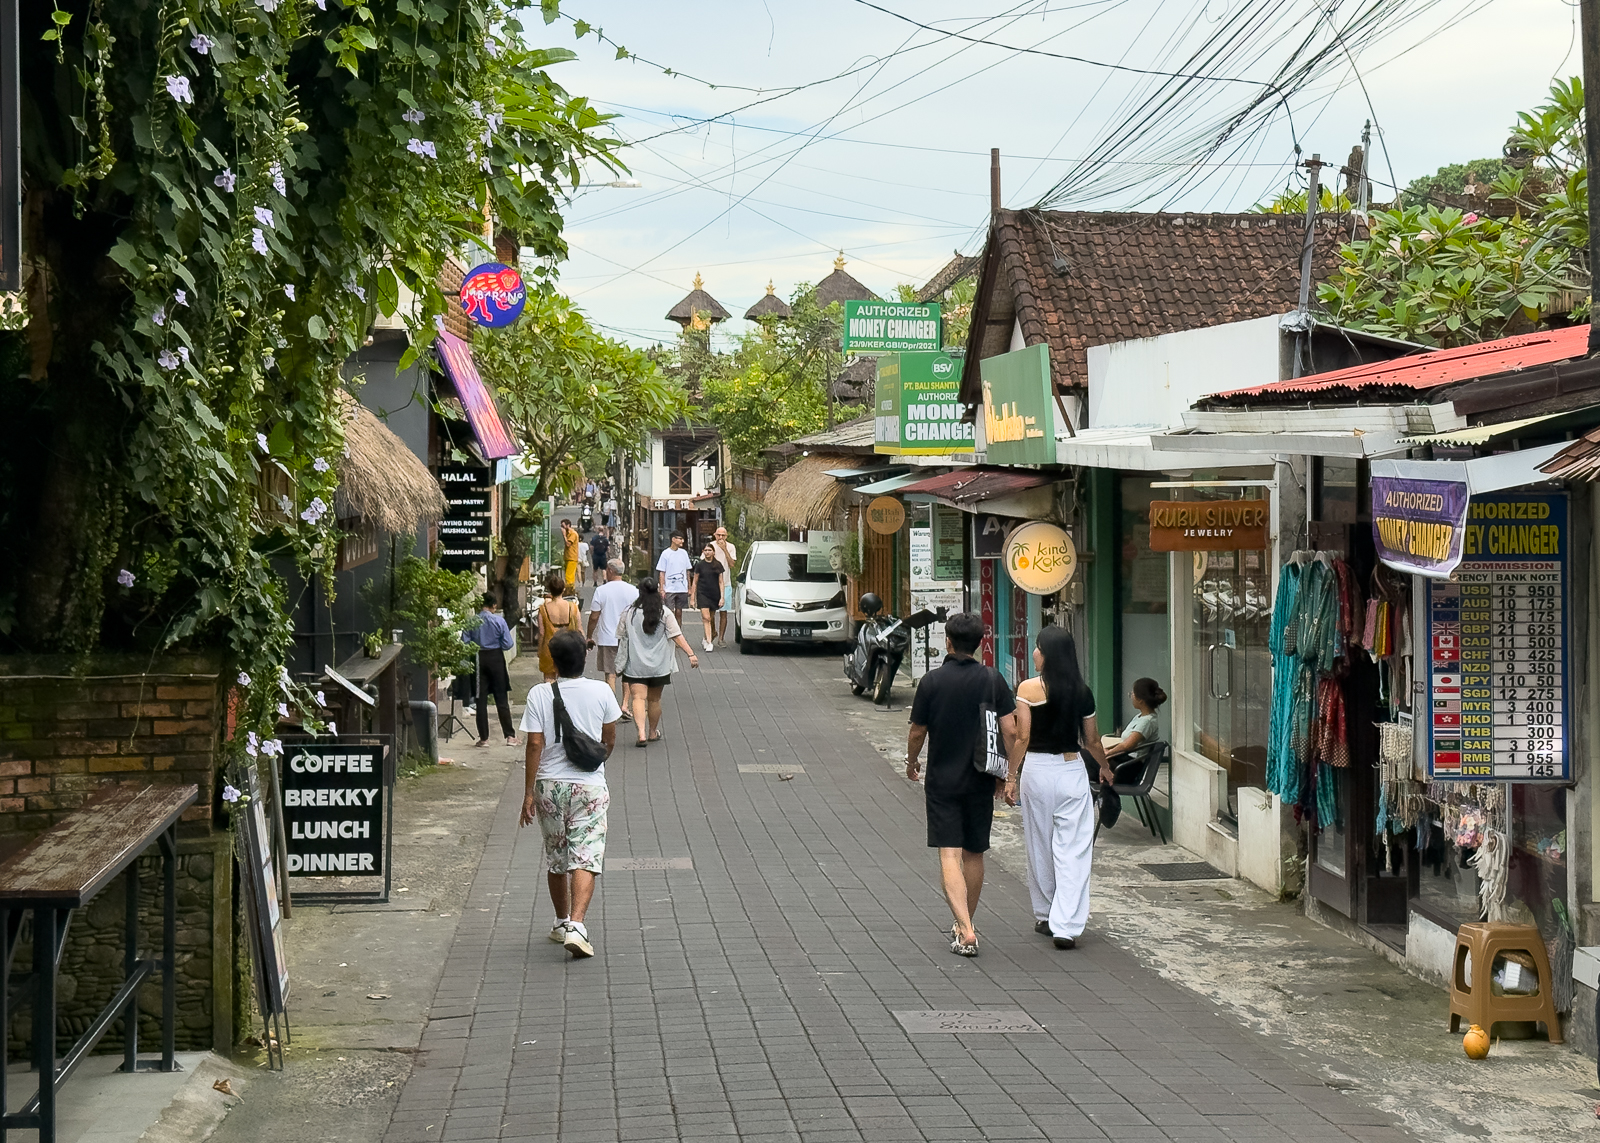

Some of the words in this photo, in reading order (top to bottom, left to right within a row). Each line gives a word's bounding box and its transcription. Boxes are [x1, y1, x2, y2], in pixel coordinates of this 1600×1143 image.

[857, 305, 930, 317] AUTHORIZED
[849, 318, 885, 338] MONEY
[887, 319, 937, 339] CHANGER
[933, 363, 952, 373] BSV
[903, 382, 914, 390] PT.
[915, 382, 930, 390] BALI
[931, 381, 955, 390] SHANTI
[918, 392, 958, 401] AUTHORIZ
[907, 403, 968, 420] MONE
[441, 473, 477, 482] HALAL
[1385, 491, 1444, 512] AUTHORIZED
[1467, 502, 1550, 519] HORIZED
[1153, 507, 1200, 528] KUBU
[1205, 507, 1264, 527] SILVER
[1183, 529, 1233, 537] JEWELRY
[1376, 516, 1408, 553] MONEY
[1409, 521, 1453, 560] CHANGER
[1488, 524, 1560, 555] CHANGER
[1037, 540, 1068, 556] kind
[1032, 555, 1072, 573] Koko
[1457, 573, 1489, 582] RENCY
[1496, 573, 1527, 582] BANK
[1530, 573, 1559, 581] NOTE
[1461, 586, 1490, 595] USD
[1498, 586, 1516, 597] 15
[1528, 585, 1555, 597] 950
[1462, 599, 1490, 608] AUD
[1498, 599, 1516, 609] 10
[1528, 598, 1555, 609] 175
[1462, 612, 1490, 621] EUR
[1498, 611, 1516, 622] 18
[1528, 611, 1555, 622] 175
[1462, 625, 1490, 633] GBP
[1498, 624, 1515, 635] 21
[1527, 624, 1555, 635] 625
[1462, 637, 1490, 646] CAD
[1498, 637, 1515, 648] 11
[1528, 637, 1555, 648] 500
[1462, 650, 1490, 659] CHF
[1498, 650, 1516, 661] 19
[1528, 650, 1555, 660] 425
[1462, 663, 1490, 672] NZD
[1506, 663, 1515, 674] 9
[1528, 663, 1555, 674] 350
[1462, 676, 1490, 685] JPY
[1499, 675, 1525, 686] 110
[1536, 675, 1554, 686] 50
[1462, 689, 1490, 698] SGD
[1499, 689, 1517, 699] 12
[1528, 688, 1555, 699] 275
[1462, 702, 1490, 710] MYR
[1507, 702, 1516, 713] 3
[1526, 701, 1554, 712] 400
[985, 709, 999, 733] DE
[1462, 715, 1491, 723] HKD
[1507, 714, 1514, 725] 1
[1527, 714, 1554, 725] 900
[1463, 728, 1491, 736] THB
[1528, 727, 1555, 738] 300
[1463, 741, 1491, 749] SAR
[1509, 740, 1518, 751] 3
[1527, 740, 1554, 751] 825
[290, 754, 373, 773] COFFEE
[1463, 753, 1491, 762] RMB
[1508, 753, 1515, 764] 1
[1527, 753, 1554, 764] 955
[1463, 766, 1491, 775] INR
[1527, 765, 1554, 776] 145
[285, 788, 379, 807] BREKKY
[292, 821, 370, 839] LUNCH
[287, 853, 374, 872] DINNER
